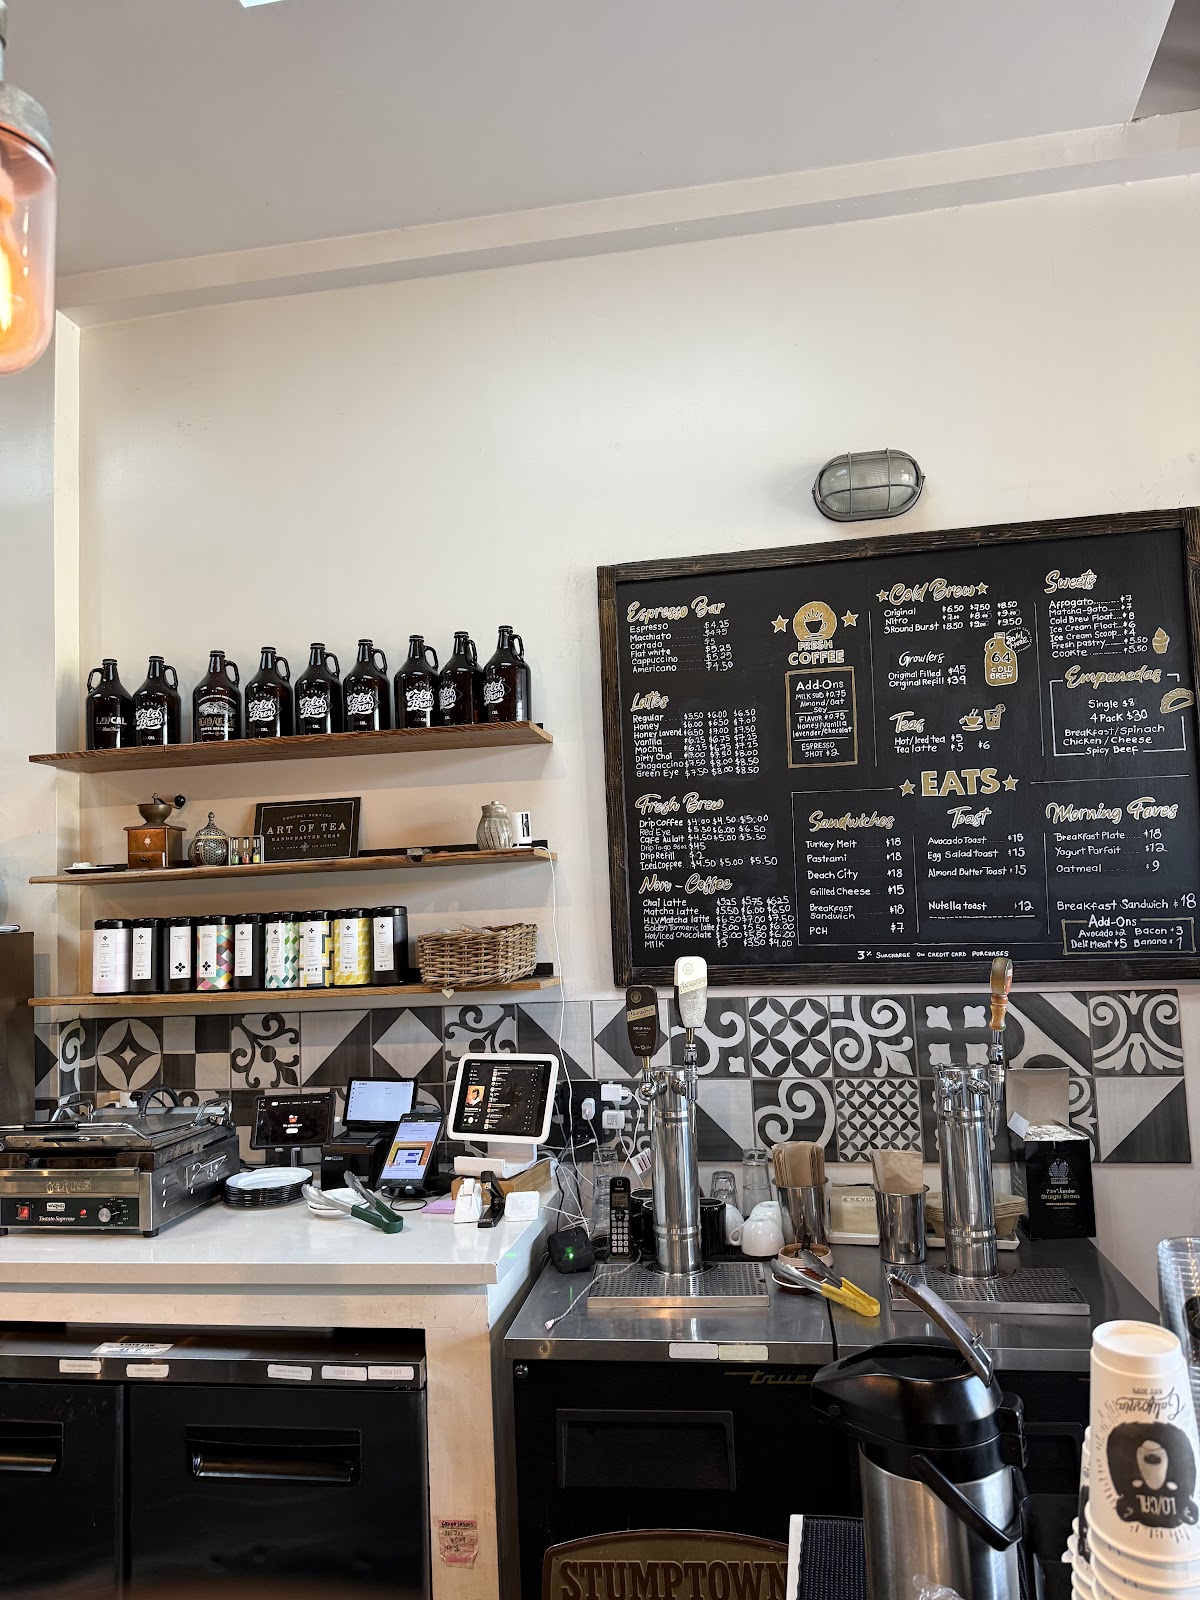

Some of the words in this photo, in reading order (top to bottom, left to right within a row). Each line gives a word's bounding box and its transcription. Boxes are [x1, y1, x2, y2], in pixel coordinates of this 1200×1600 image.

[1044, 569, 1097, 594] Sweets
[889, 582, 928, 605] Cold
[929, 578, 976, 601] Brew
[1049, 598, 1094, 609] Affogato
[627, 601, 688, 624] Espresso
[691, 596, 725, 618] Bar
[884, 608, 915, 618] Original
[1050, 616, 1067, 625] Cold
[1092, 614, 1113, 622] Float
[630, 623, 668, 634] Espresso
[915, 622, 939, 631] Burst
[1049, 626, 1062, 634] Ice
[1065, 624, 1091, 632] Cream
[1094, 622, 1117, 630] Float
[630, 632, 671, 642] Macchiato
[1095, 630, 1117, 640] Scoop
[630, 642, 662, 650] Cortado
[798, 640, 833, 651] FRESH
[1052, 641, 1074, 649] Fresh
[631, 650, 646, 658] Flat
[648, 648, 670, 656] white
[788, 650, 844, 665] COFFEE
[991, 652, 1012, 663] 64
[632, 656, 678, 667] Cappuccino
[899, 651, 945, 667] Growlers
[633, 665, 677, 673] Americano
[888, 672, 917, 680] Original
[920, 669, 941, 678] Filled
[1065, 664, 1162, 689] Empanadas
[796, 680, 844, 691] Add-Ons
[889, 678, 920, 690] Original
[922, 677, 944, 686] Refill
[347, 692, 373, 705] Cold
[406, 689, 433, 700] Cold
[249, 698, 275, 711] Cold
[299, 695, 326, 708] Cold
[406, 700, 434, 711] Brew
[630, 691, 669, 712] Lattes
[1088, 700, 1118, 711] Single
[136, 707, 163, 720] Cold
[300, 706, 327, 718] Brew
[348, 703, 374, 715] Brew
[249, 710, 276, 722] Brew
[633, 714, 664, 723] Regular
[1127, 709, 1148, 721] $30
[136, 718, 163, 730] Brew
[634, 723, 659, 732] Honey
[889, 711, 925, 733] Teas
[634, 731, 657, 740] Honey
[931, 735, 945, 743] tea
[951, 734, 963, 742] $5
[634, 738, 662, 746] Vanilla
[801, 742, 835, 750] ESPRESSO
[911, 744, 937, 753] latte
[951, 743, 963, 752] $5
[978, 740, 990, 749] $6
[635, 746, 662, 754] Mocha
[1085, 747, 1109, 756] Spicy
[1114, 746, 1138, 754] Beef
[656, 752, 672, 760] Chai
[663, 769, 679, 778] Eye
[921, 768, 1000, 797] EATS
[635, 794, 680, 815] Fresh
[682, 792, 724, 813] Brew
[1046, 803, 1122, 824] Morning
[1127, 796, 1178, 820] Faves
[639, 818, 655, 828] Drip
[656, 819, 683, 828] Coffee
[809, 810, 895, 832] Sandwiches
[947, 806, 992, 829] Toast
[267, 825, 293, 835] ART
[299, 824, 315, 832] OF
[321, 822, 346, 831] TEA
[656, 829, 670, 837] Eye
[928, 837, 963, 845] Avocado
[964, 836, 987, 844] Toast
[1054, 832, 1100, 842] Breakfast
[1102, 830, 1125, 840] Plate
[1143, 829, 1162, 839] $18
[805, 840, 834, 850] Turkey
[837, 840, 857, 848] Melt
[886, 838, 901, 847] $18
[928, 852, 942, 862] Egg
[945, 850, 972, 858] Salad
[1008, 848, 1025, 857] $15
[1055, 847, 1086, 858] Yogurt
[1088, 845, 1121, 854] Parfait
[1146, 843, 1168, 852] $12
[641, 852, 655, 861] Drip
[807, 854, 847, 863] Pastrami
[640, 861, 657, 870] Iced
[750, 856, 777, 865] $5.50
[1056, 864, 1101, 873] Oatmeal
[807, 870, 835, 879] Beach
[837, 868, 858, 880] City
[887, 869, 903, 878] $18
[928, 868, 956, 877] Almond
[982, 866, 1007, 875] Toast
[810, 887, 835, 895] Grilled
[836, 887, 871, 895] Cheese
[643, 898, 660, 906] Chai
[663, 898, 687, 906] Latte
[928, 901, 961, 910] Nutella
[963, 902, 987, 910] toast
[1057, 899, 1117, 911] Breakfast
[1120, 899, 1168, 909] Sandwich
[676, 907, 699, 915] latte
[810, 904, 853, 912] Breakfast
[691, 915, 710, 923] latte
[810, 912, 855, 920] Sandwich
[1088, 914, 1136, 927] Add-Ons
[810, 927, 828, 935] PCH
[891, 922, 904, 933] $7
[1078, 930, 1113, 938] Avocado
[676, 931, 711, 939] Chocolate
[1070, 939, 1087, 949] Deli
[1090, 939, 1111, 948] Meat
[1114, 939, 1127, 948] $5
[1134, 939, 1167, 947] Banana
[1116, 1390, 1184, 1420] California
[560, 1560, 788, 1600] STUMPTOWN
